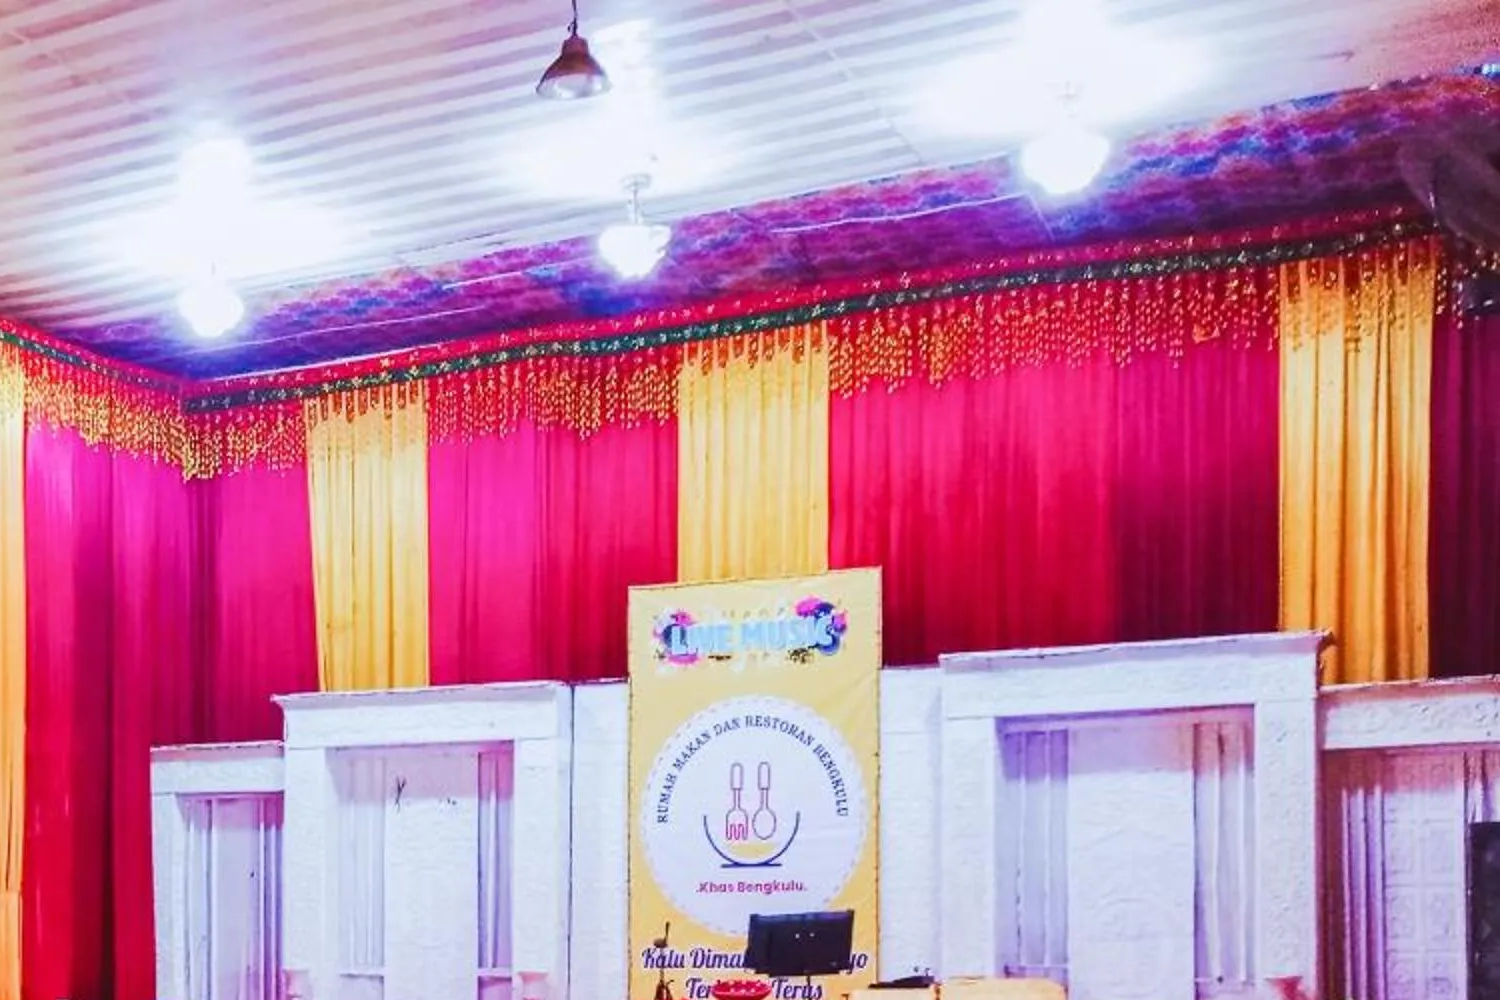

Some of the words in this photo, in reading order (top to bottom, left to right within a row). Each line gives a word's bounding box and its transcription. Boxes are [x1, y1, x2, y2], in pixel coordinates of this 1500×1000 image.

[670, 622, 735, 656] LIVE
[657, 773, 677, 824] RUMAH
[672, 730, 712, 773] MAKAN
[713, 717, 741, 736] DAN
[744, 715, 816, 747] RESTORAN
[812, 743, 849, 817] BENGKULU
[641, 947, 685, 969] Kalu
